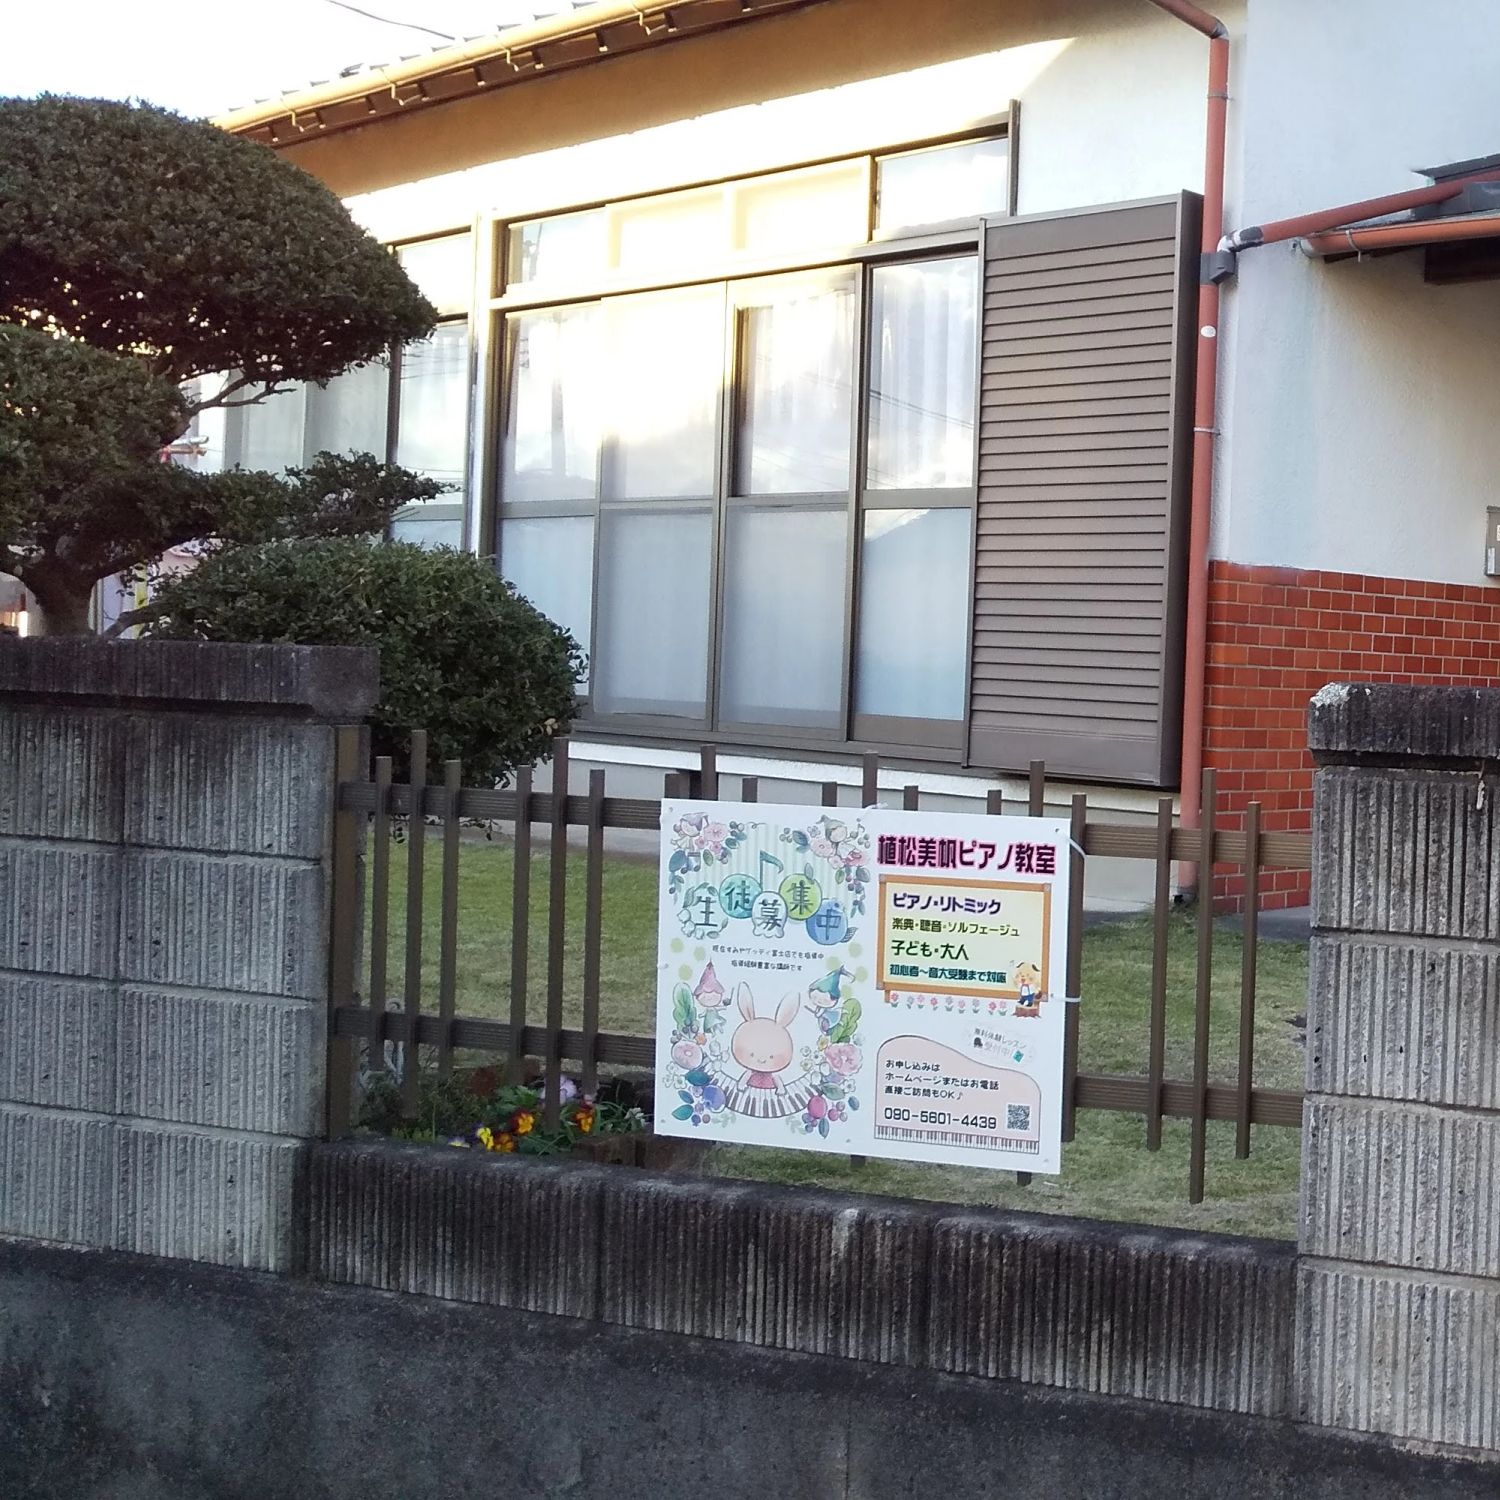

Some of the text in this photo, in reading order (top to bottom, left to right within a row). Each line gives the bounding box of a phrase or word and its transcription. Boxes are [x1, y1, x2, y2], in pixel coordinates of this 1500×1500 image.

[878, 835, 1056, 875] 植松美帆ピアノ教室
[695, 879, 842, 941] 生徒募集中
[891, 940, 969, 960] 子ども・大人
[885, 1059, 941, 1072] お申し込みは
[885, 1073, 1000, 1091] ホームページまたはお電話
[884, 1107, 997, 1130] 090-5601-4439
